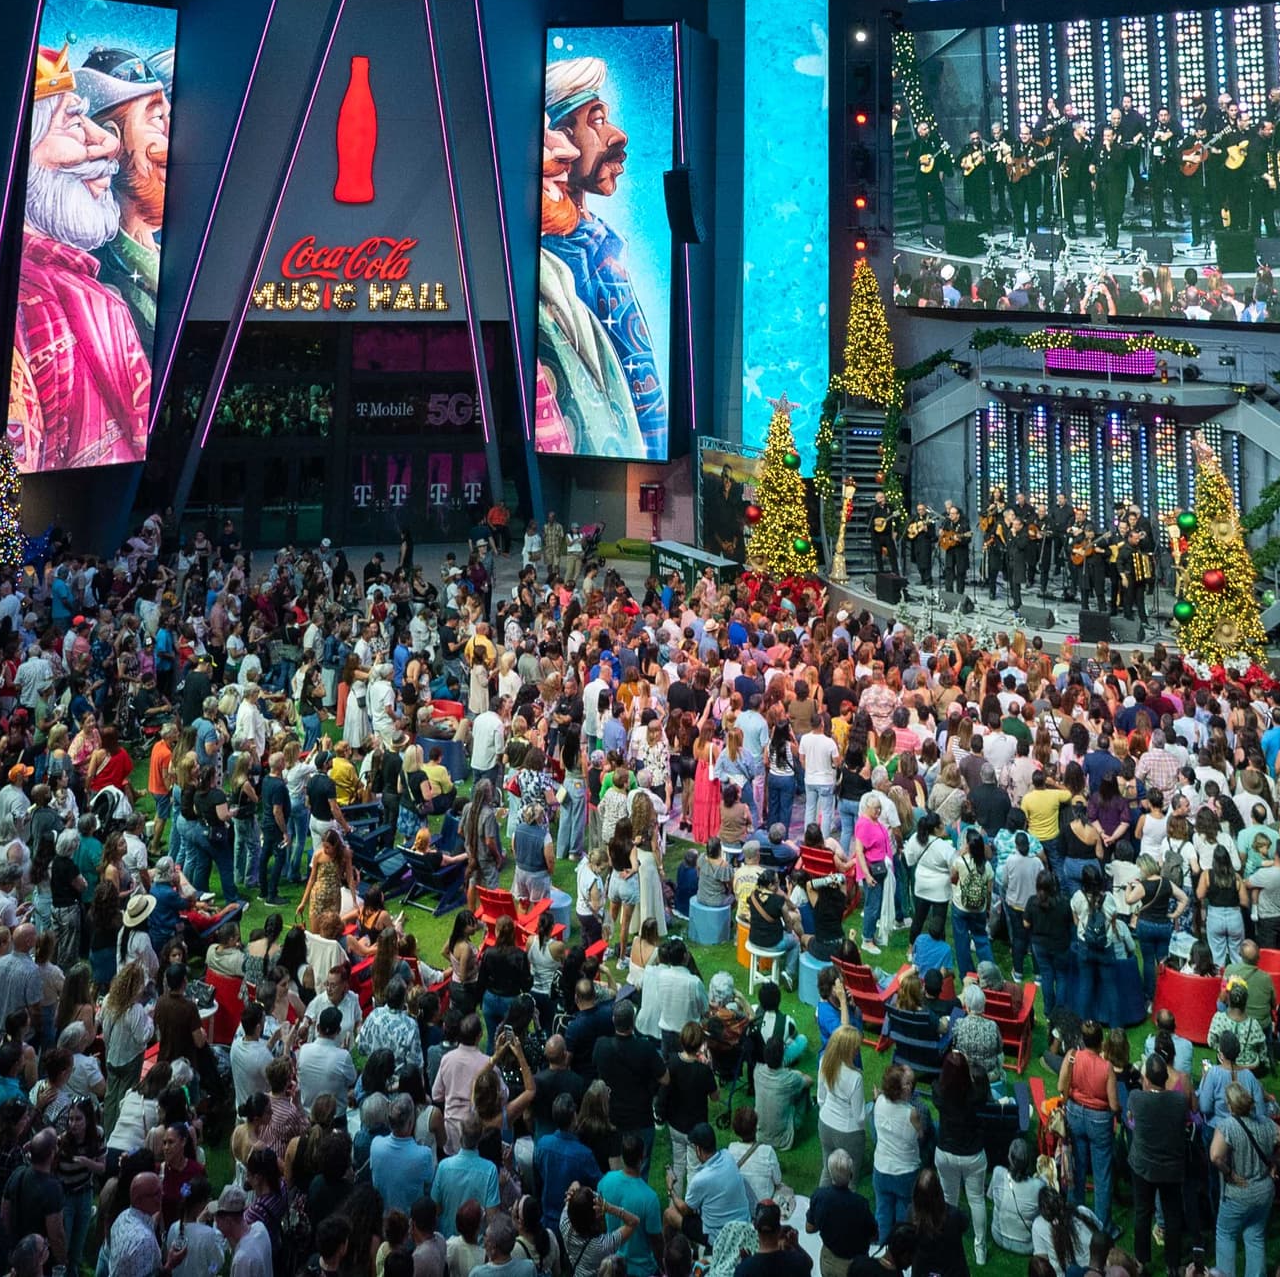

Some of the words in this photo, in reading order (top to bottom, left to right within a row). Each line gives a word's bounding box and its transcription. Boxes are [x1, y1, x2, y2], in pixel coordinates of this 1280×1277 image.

[281, 235, 418, 281] Coca-Cola
[368, 281, 450, 311] HALL
[427, 393, 472, 426] 5G
